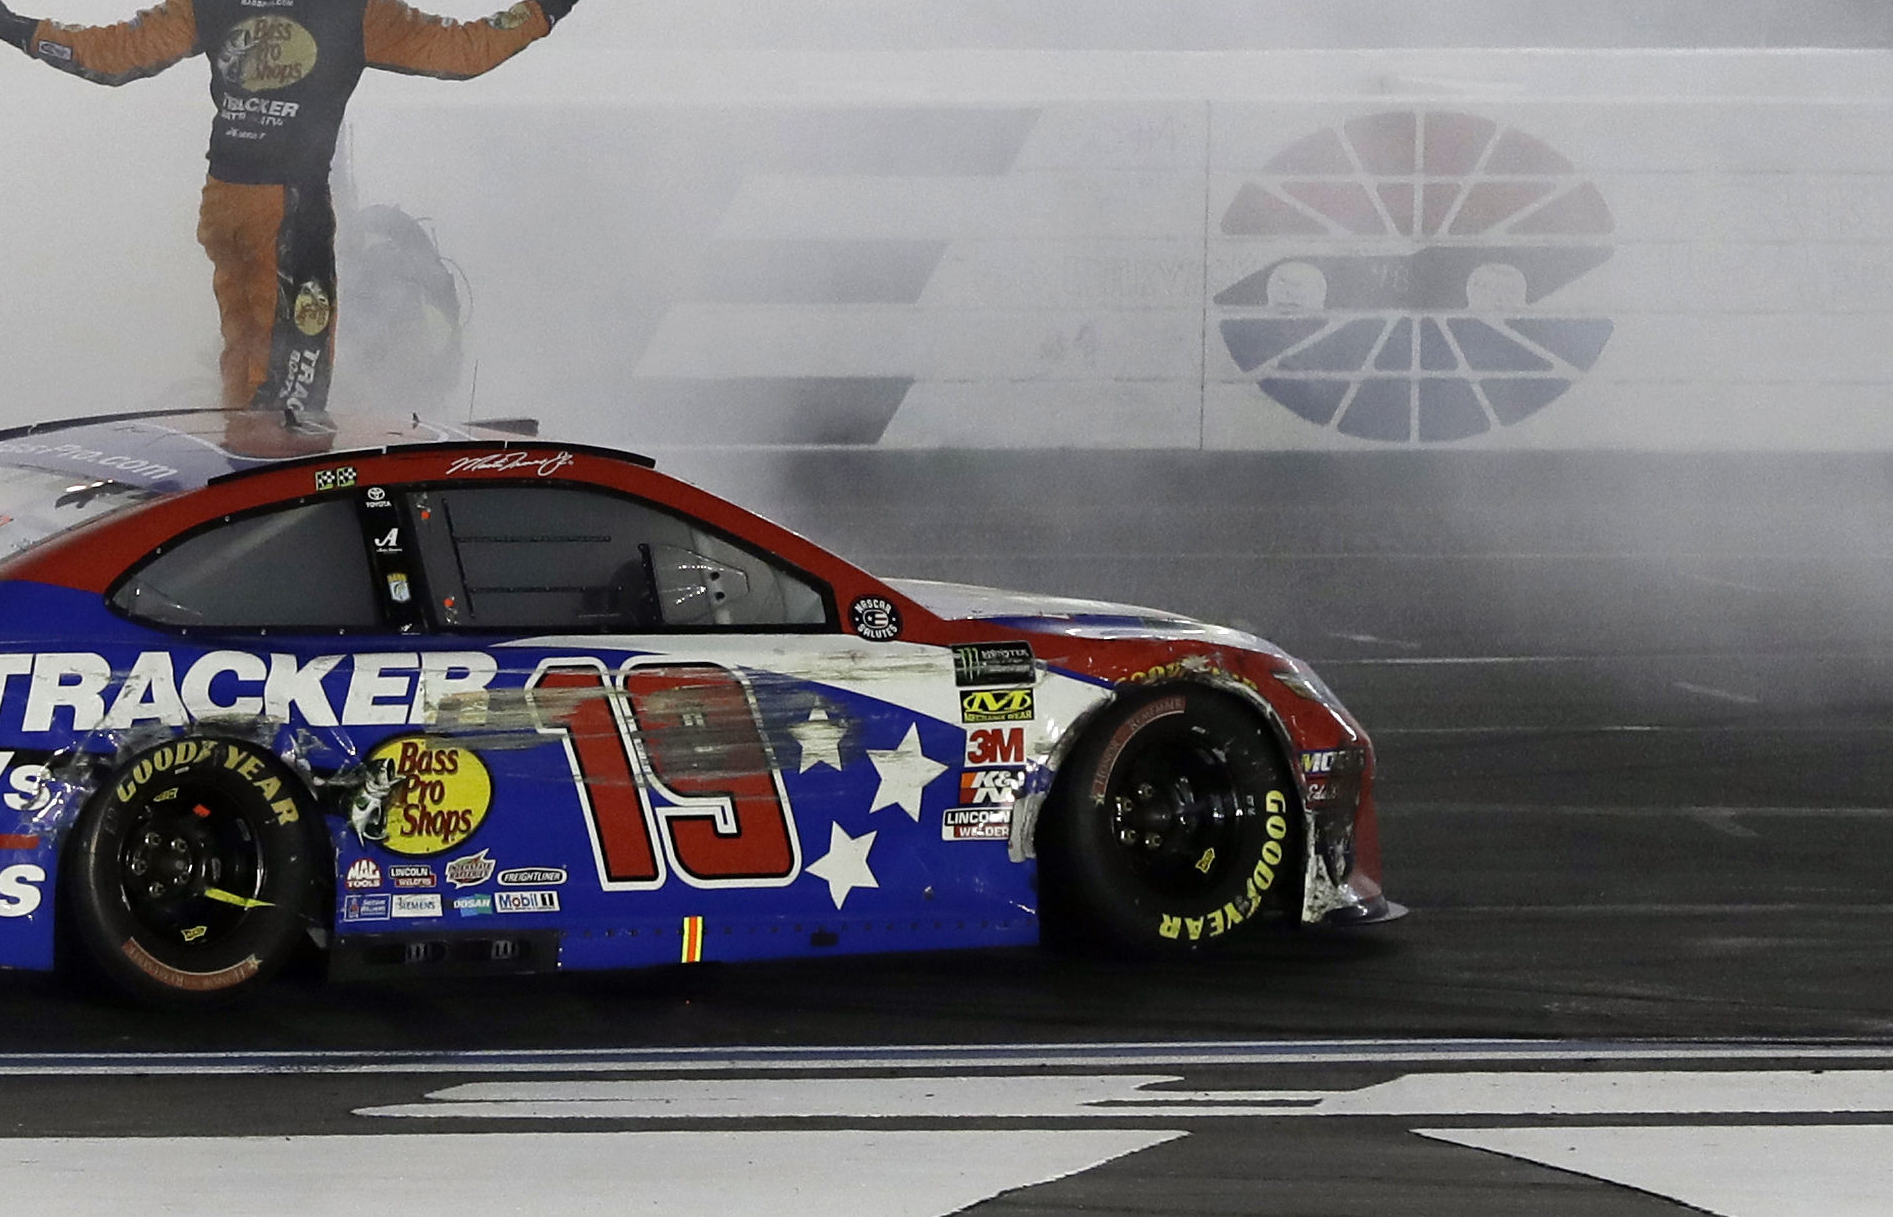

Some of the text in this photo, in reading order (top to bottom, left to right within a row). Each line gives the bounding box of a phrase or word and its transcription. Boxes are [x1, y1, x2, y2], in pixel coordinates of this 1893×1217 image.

[855, 599, 892, 615] NASCAR
[858, 623, 898, 639] SALUTES
[967, 728, 1024, 764] 3M
[397, 742, 459, 775] Bass
[523, 655, 802, 891] 19
[401, 774, 445, 807] Pro
[401, 804, 473, 844] Shops
[391, 867, 429, 877] LINCOLN
[503, 871, 561, 882] FREIGHTLINER
[348, 880, 381, 888] TOOLS
[499, 894, 538, 908] Mobil
